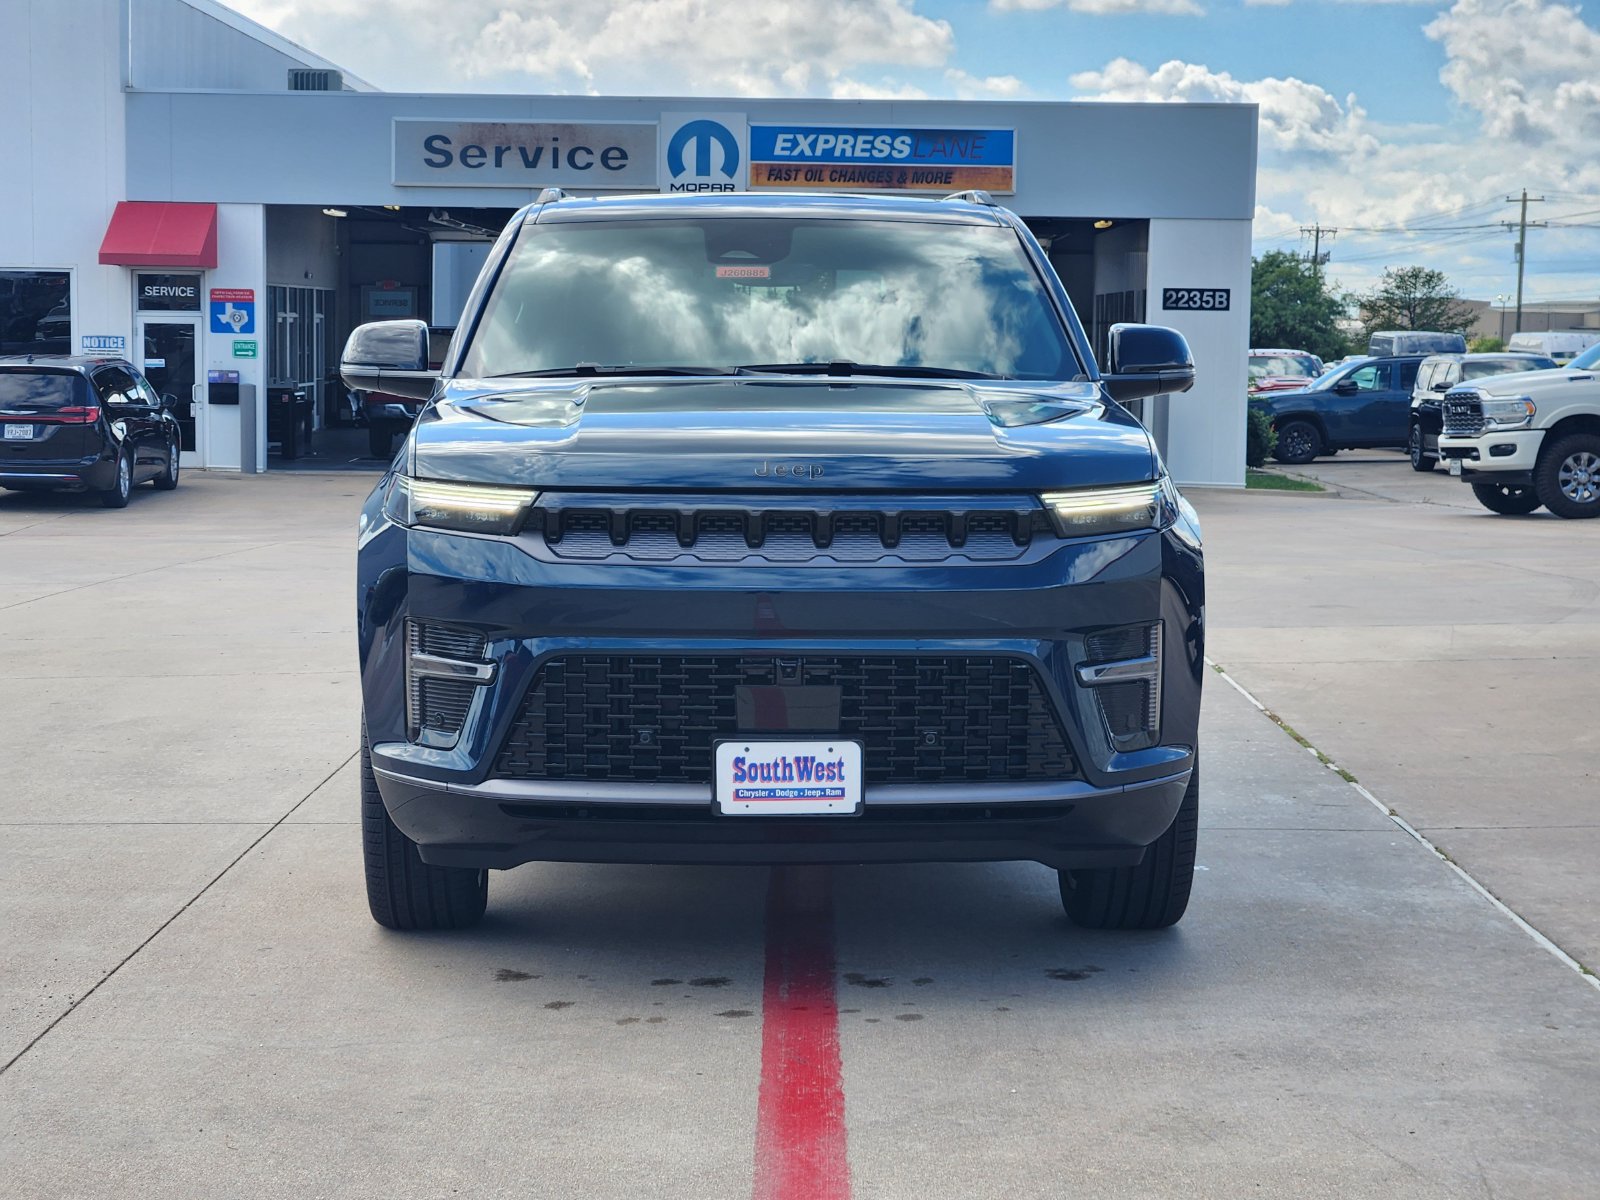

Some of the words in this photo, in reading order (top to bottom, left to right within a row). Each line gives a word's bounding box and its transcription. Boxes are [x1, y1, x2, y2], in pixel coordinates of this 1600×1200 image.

[423, 134, 629, 170] Service
[773, 133, 912, 159] EXPRESS
[912, 136, 987, 159] LANE
[767, 167, 800, 182] FAST
[804, 169, 825, 183] OIL
[829, 170, 893, 184] CHANGES
[896, 173, 907, 184] &
[911, 171, 953, 184] MORE
[671, 183, 735, 192] MOPAR
[144, 285, 194, 297] SERVICE
[1165, 290, 1228, 308] 2235B
[83, 336, 124, 348] NOTICE
[754, 461, 824, 480] Jeep
[732, 755, 845, 783] SouthWest
[738, 789, 769, 798] Chrysler
[775, 788, 798, 798] Dodge
[804, 788, 821, 797] Jeep
[825, 788, 842, 796] Ram
